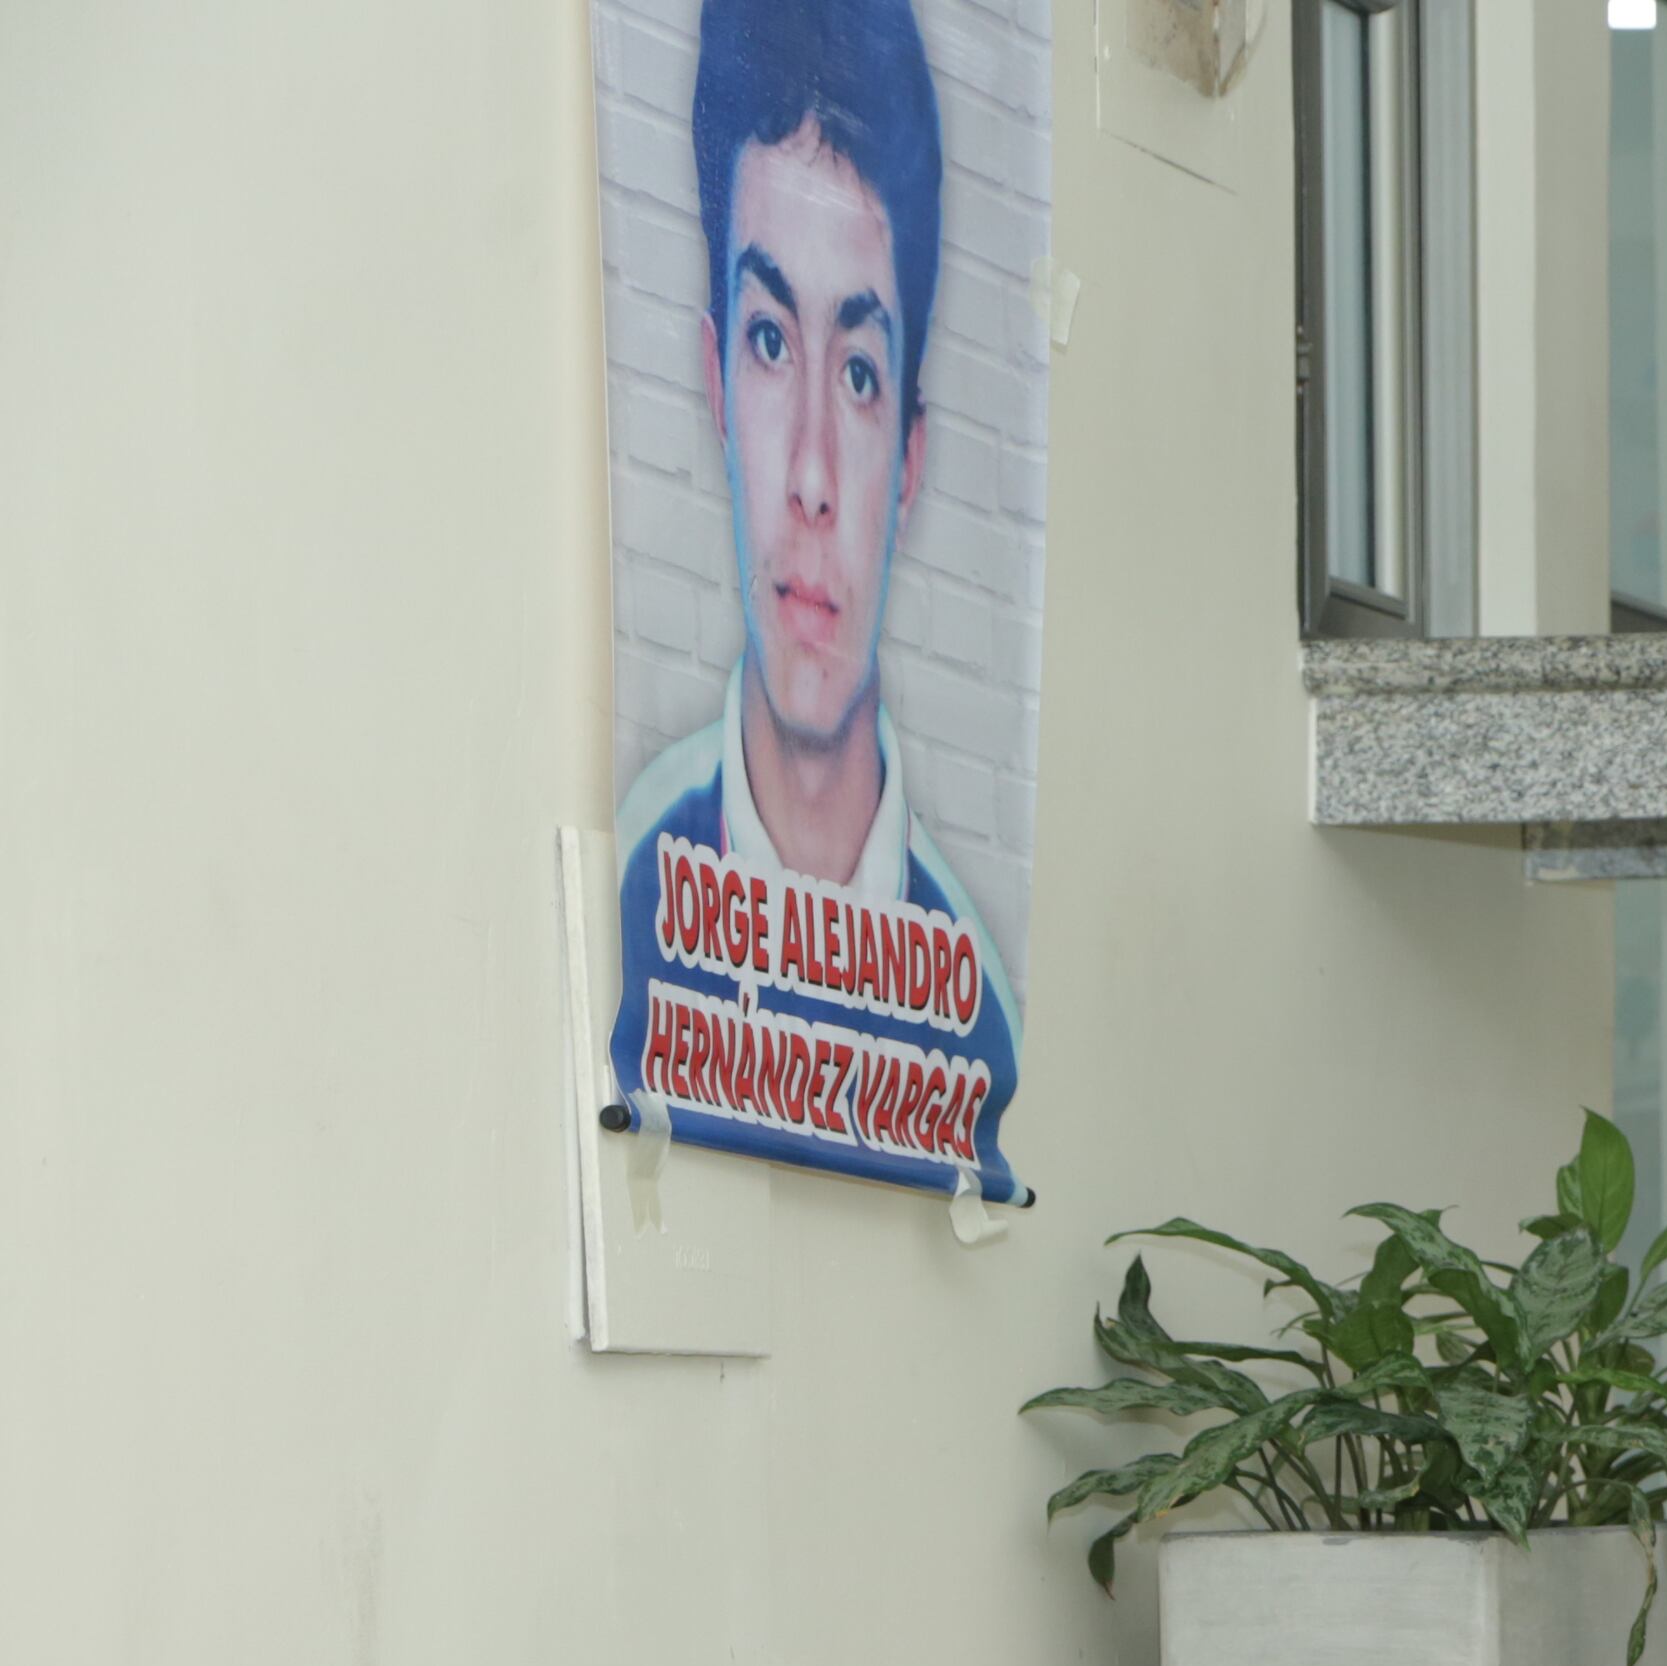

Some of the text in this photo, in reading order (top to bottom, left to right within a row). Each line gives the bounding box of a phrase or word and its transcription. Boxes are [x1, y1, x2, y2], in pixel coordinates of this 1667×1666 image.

[661, 850, 979, 1025] JORGE ALEJANDRO
[645, 993, 988, 1162] HERNÁNDEZ VARGAS
